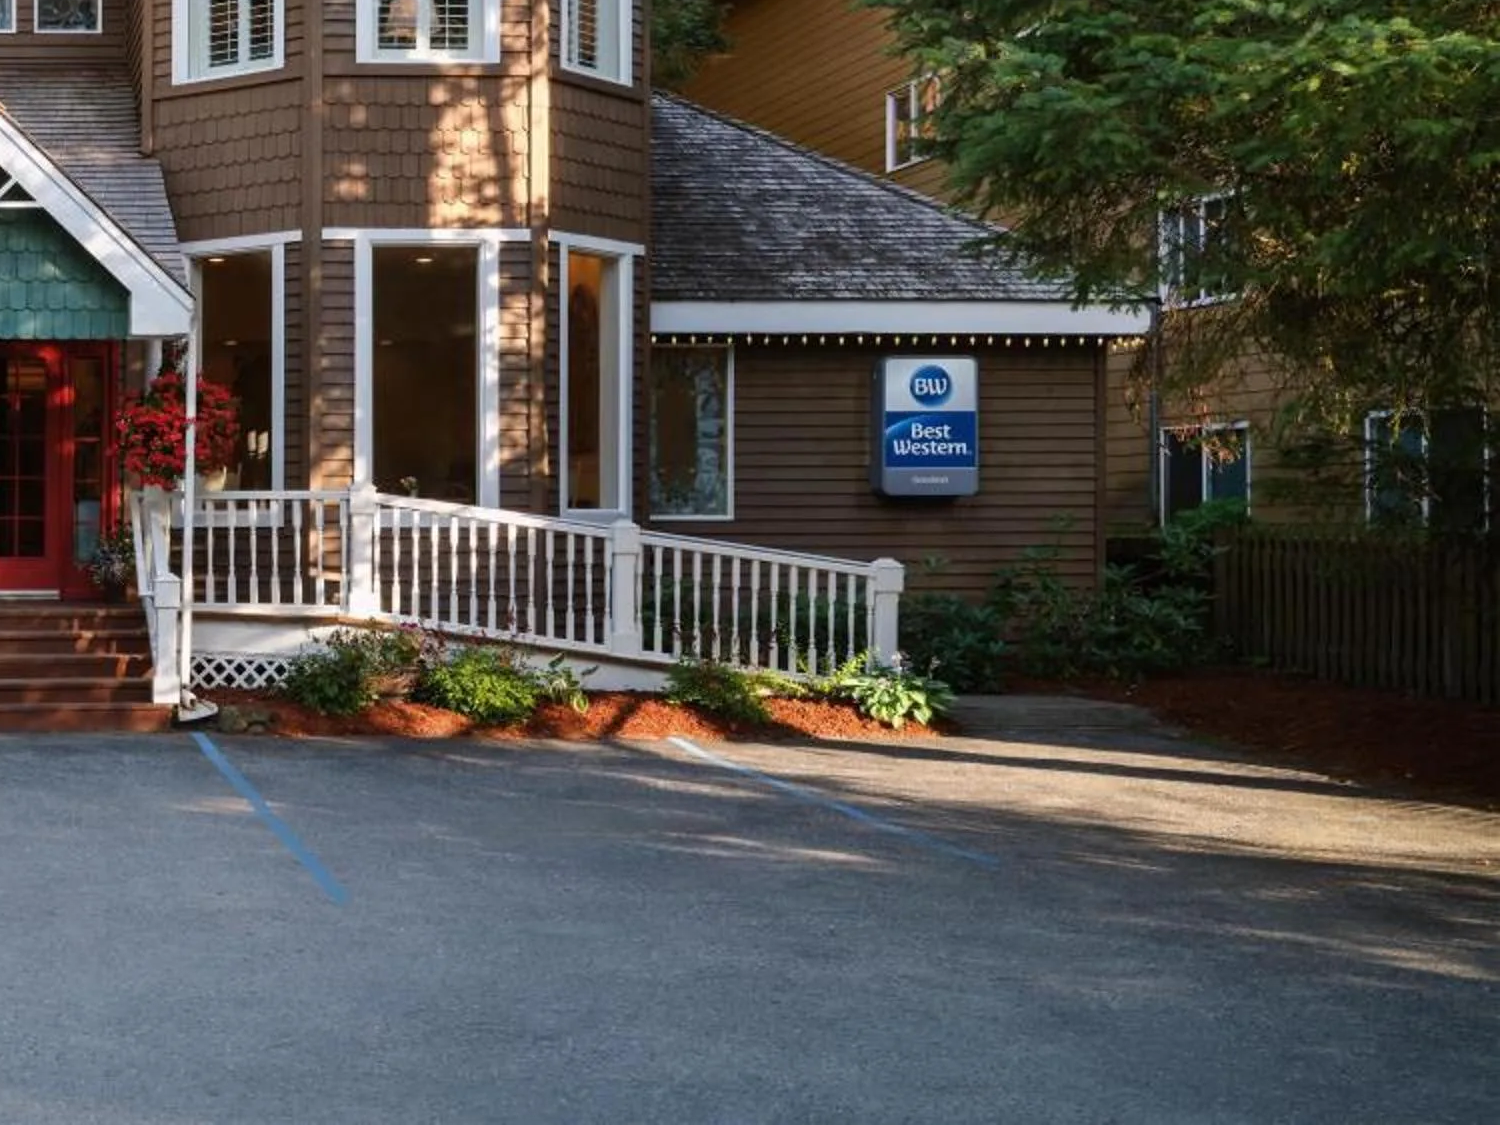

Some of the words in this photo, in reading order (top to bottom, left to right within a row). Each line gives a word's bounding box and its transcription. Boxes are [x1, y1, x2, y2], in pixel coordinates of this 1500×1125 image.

[914, 378, 947, 396] BW
[911, 422, 951, 439] Best
[893, 440, 967, 456] Western
